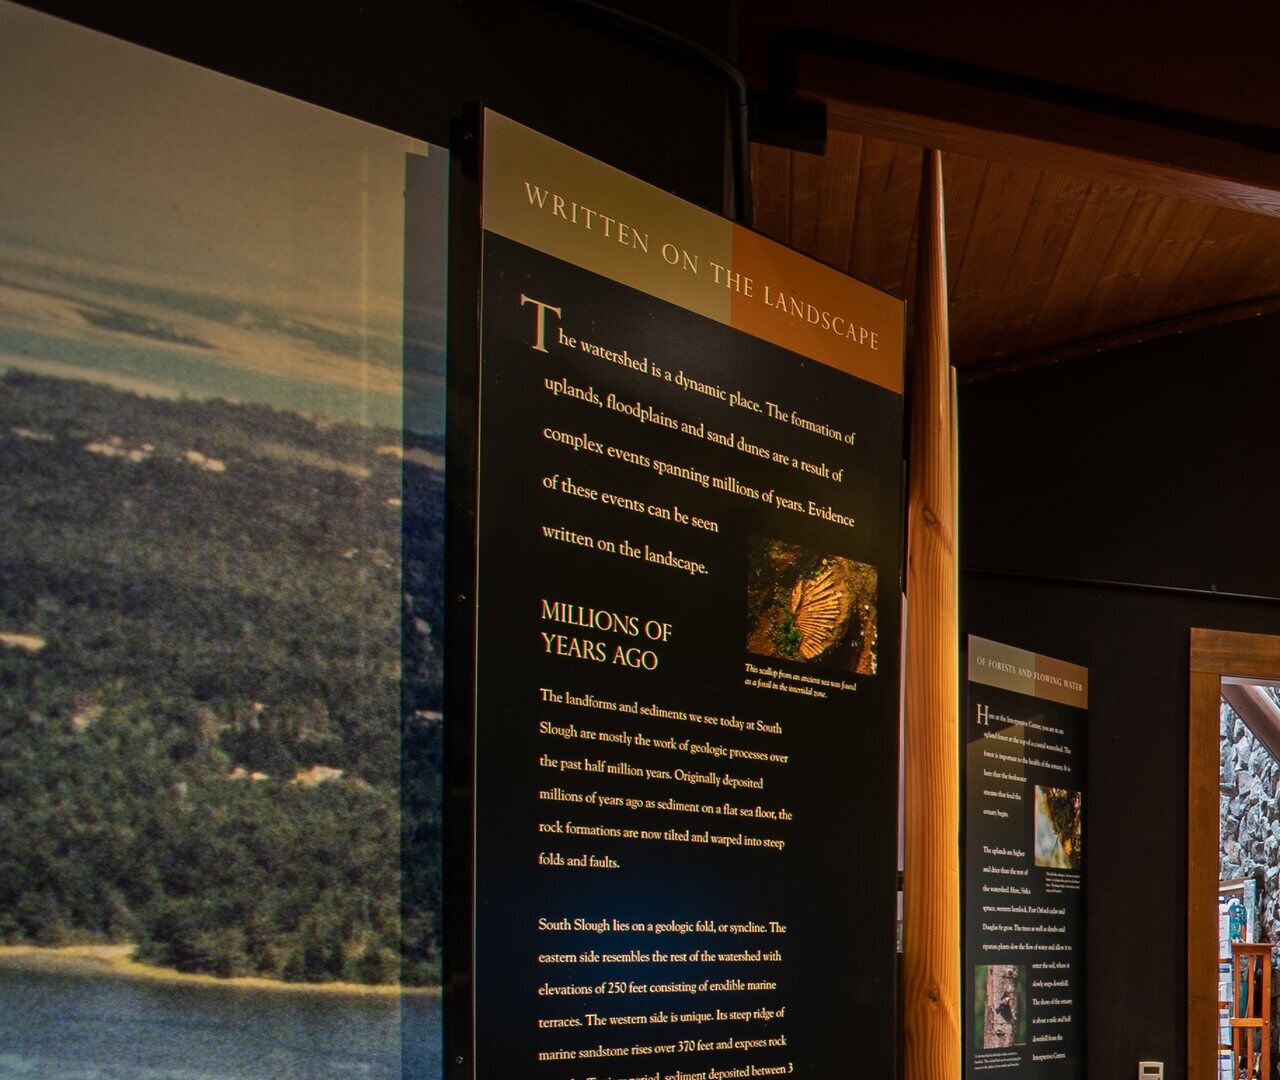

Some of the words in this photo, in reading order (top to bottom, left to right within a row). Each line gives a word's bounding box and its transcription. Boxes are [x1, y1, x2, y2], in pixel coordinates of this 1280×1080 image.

[524, 181, 648, 253] WRITTEN
[660, 243, 698, 274] ON
[710, 262, 753, 299] THE
[762, 285, 879, 351] LANDSCAPE
[521, 294, 576, 354] The
[580, 341, 647, 373] watershed
[651, 362, 661, 378] is
[664, 371, 672, 382] a
[675, 370, 726, 400] dynamic
[729, 391, 762, 413] place.
[765, 401, 788, 422] The
[791, 411, 842, 441] formation
[844, 432, 853, 445] of
[544, 378, 603, 408] uplands,
[606, 393, 678, 430] floodplains
[681, 422, 704, 438] and
[707, 431, 734, 448] sand
[736, 436, 770, 459] dunes
[772, 452, 789, 465] are
[791, 458, 798, 469] a
[801, 461, 829, 478] result
[831, 469, 843, 482] of
[542, 475, 558, 490] of
[561, 478, 598, 500] these
[601, 493, 645, 513] events
[647, 505, 671, 520] can
[674, 507, 689, 524] be
[691, 517, 719, 533] seen
[543, 428, 603, 454] complex
[607, 447, 650, 467] events
[653, 460, 709, 488] spanning
[712, 477, 759, 499] millions
[761, 490, 773, 503] of
[775, 496, 805, 513] years.
[808, 501, 855, 527] Evidence
[542, 526, 594, 548] written
[597, 540, 615, 553] on
[618, 543, 641, 559] the
[644, 548, 708, 575] landscape.
[541, 599, 639, 636] MILLIONS
[644, 620, 672, 641] OF
[541, 632, 606, 662] YEARS
[612, 645, 658, 670] AGO
[977, 657, 985, 666] OF
[989, 659, 1016, 674] FORESTS
[1018, 668, 1032, 678] AND
[1034, 672, 1062, 686] FLOWING
[1064, 680, 1082, 692] WATER
[539, 688, 563, 703] The
[565, 691, 617, 711] landforms
[619, 701, 638, 714] and
[640, 704, 687, 720] sediments
[689, 714, 702, 723] we
[703, 716, 718, 725] see
[720, 716, 744, 731] today
[746, 722, 755, 730] at
[756, 720, 782, 734] South
